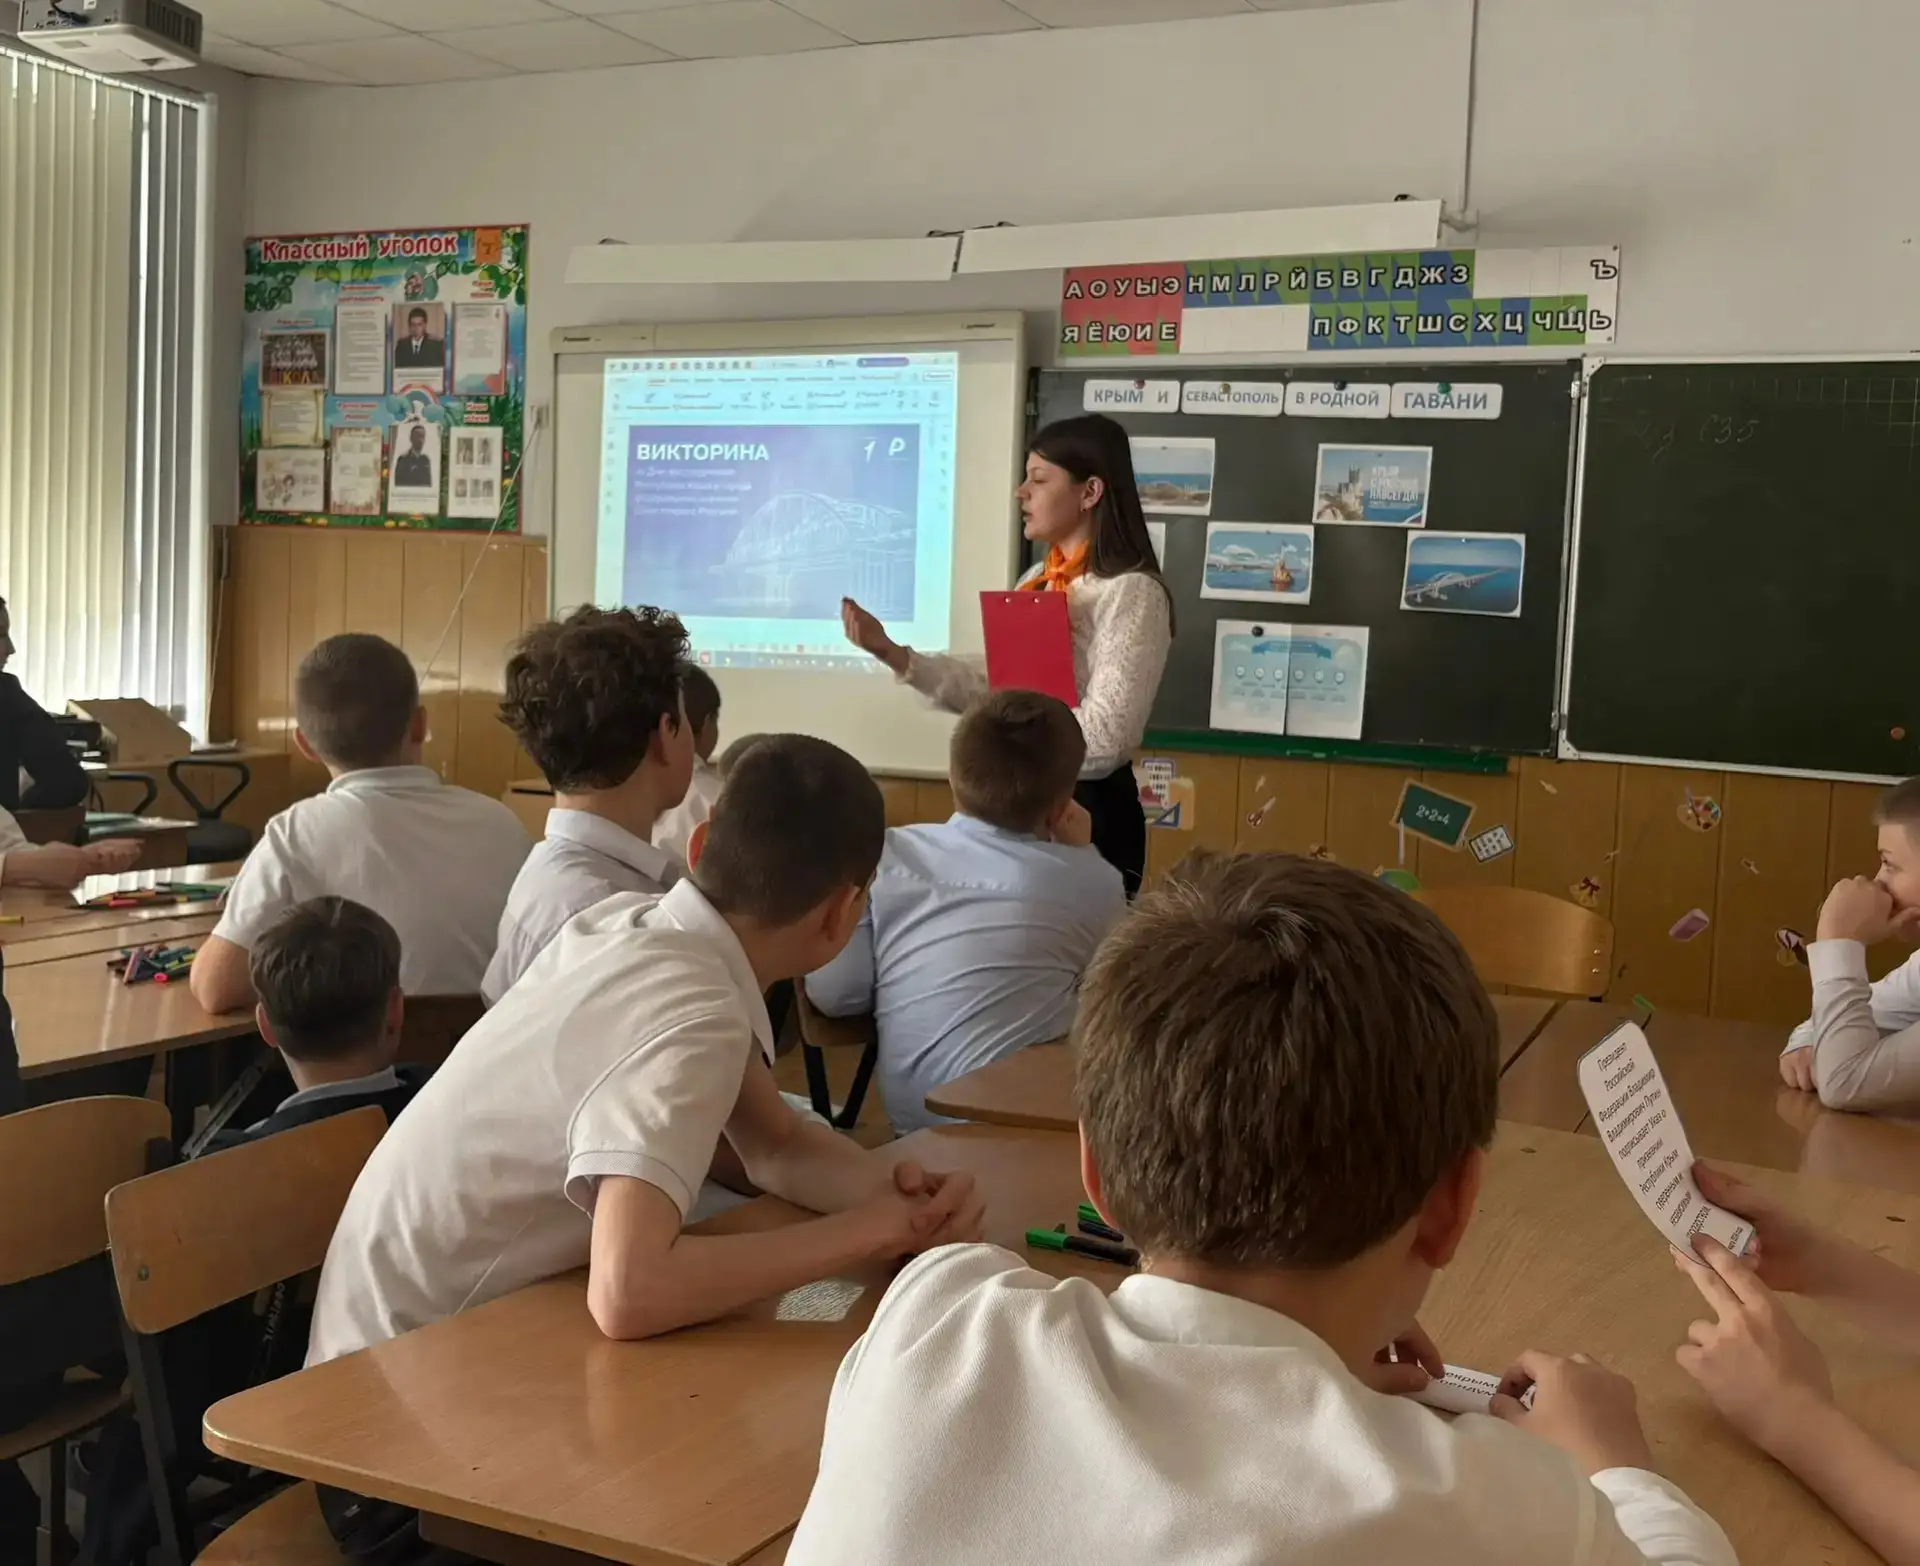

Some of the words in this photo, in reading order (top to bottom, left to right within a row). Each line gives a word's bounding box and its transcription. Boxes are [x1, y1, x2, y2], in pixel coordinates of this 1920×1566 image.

[263, 235, 368, 261] Классный
[378, 235, 457, 257] уголок
[1093, 389, 1144, 405] КРЫМ
[1157, 390, 1169, 405] И
[1185, 391, 1279, 405] СЕВАСТОПОЛЬ
[1295, 392, 1305, 405] В
[1309, 391, 1380, 407] РОДНОЙ
[1402, 392, 1488, 410] ГАВАНИ
[636, 443, 770, 461] ВИКТОРИНА
[1597, 1042, 1627, 1071] Президент
[1603, 1057, 1636, 1092] Российской
[1598, 1090, 1631, 1123] Федерации
[1627, 1067, 1656, 1097] Владимир
[1606, 1101, 1647, 1143] Владимирович
[1643, 1088, 1662, 1111] Путин
[1618, 1121, 1652, 1160] подписывает
[1648, 1113, 1663, 1130] Указ
[1636, 1137, 1665, 1170] признании
[1638, 1161, 1667, 1196] Республики
[1663, 1148, 1680, 1169] Крым
